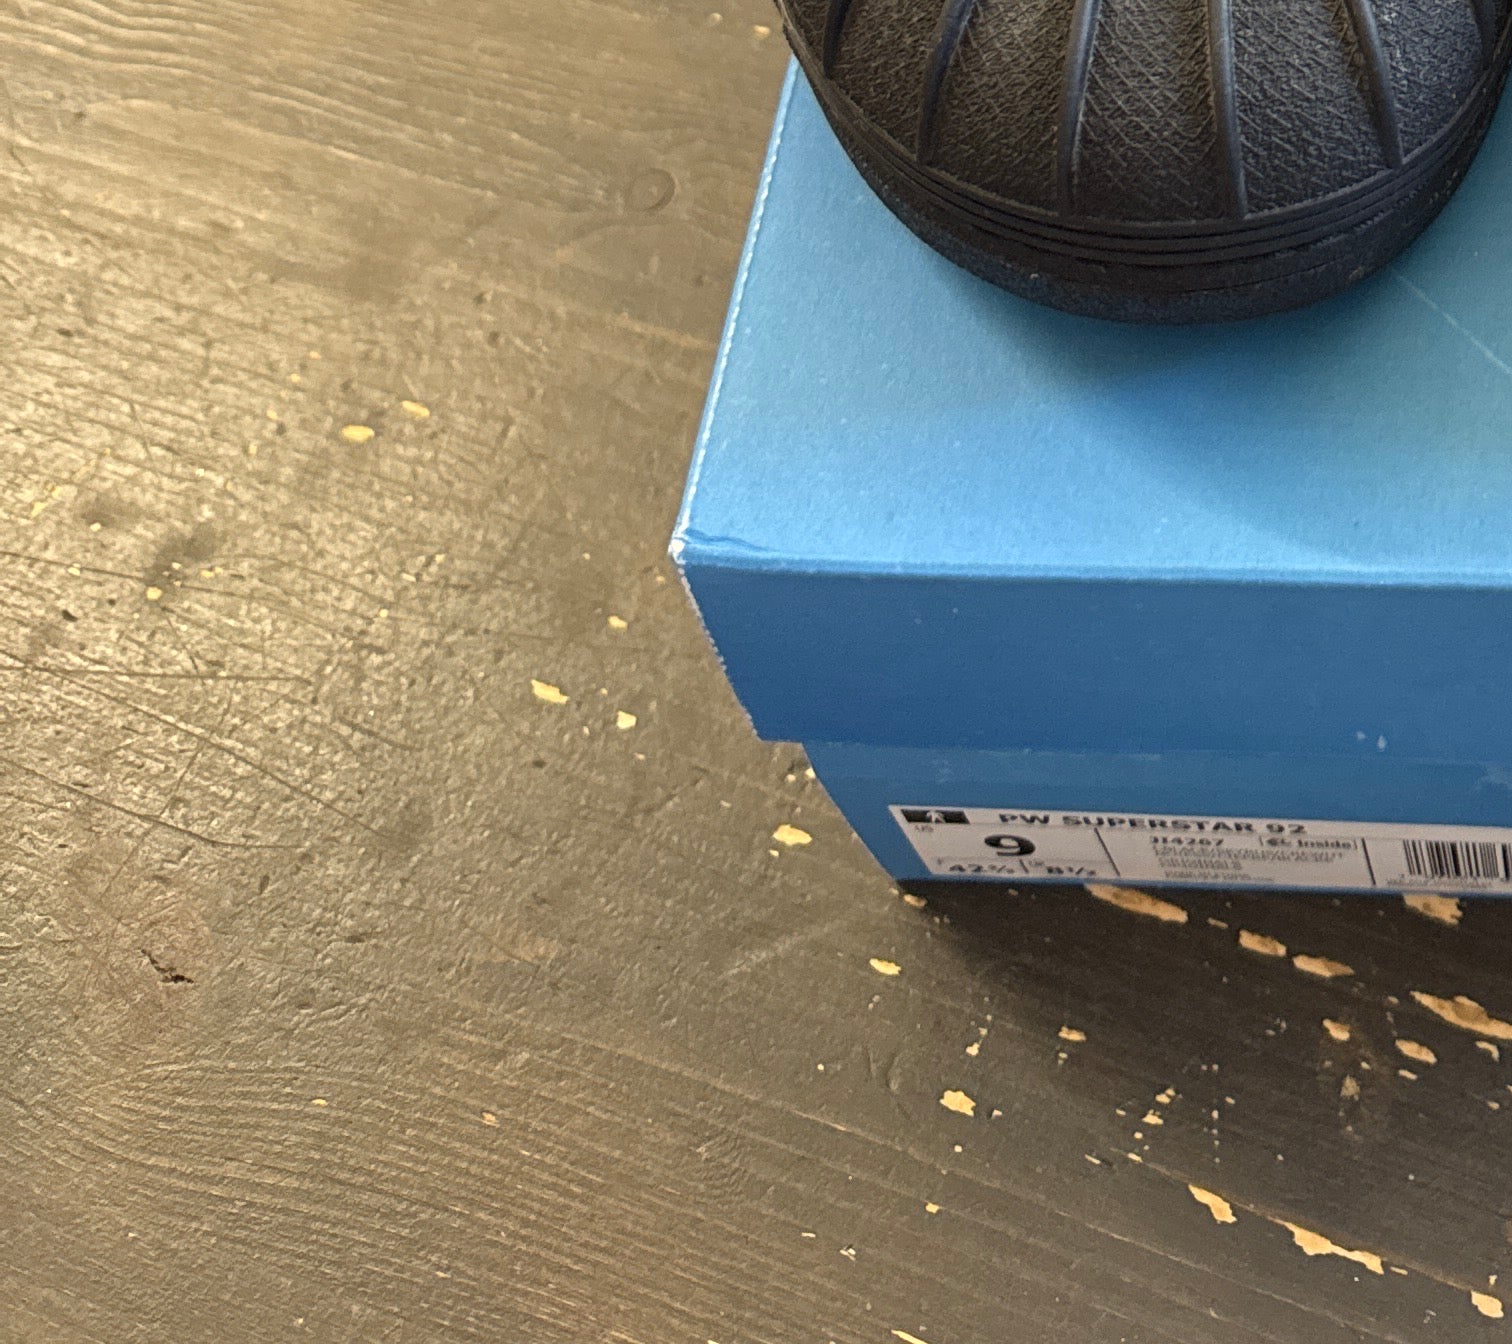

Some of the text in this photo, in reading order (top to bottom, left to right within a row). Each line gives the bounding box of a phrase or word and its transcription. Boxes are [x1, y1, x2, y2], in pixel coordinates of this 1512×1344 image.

[999, 813, 1307, 835] PW SUPERSTAR 92
[983, 834, 1036, 857] 9
